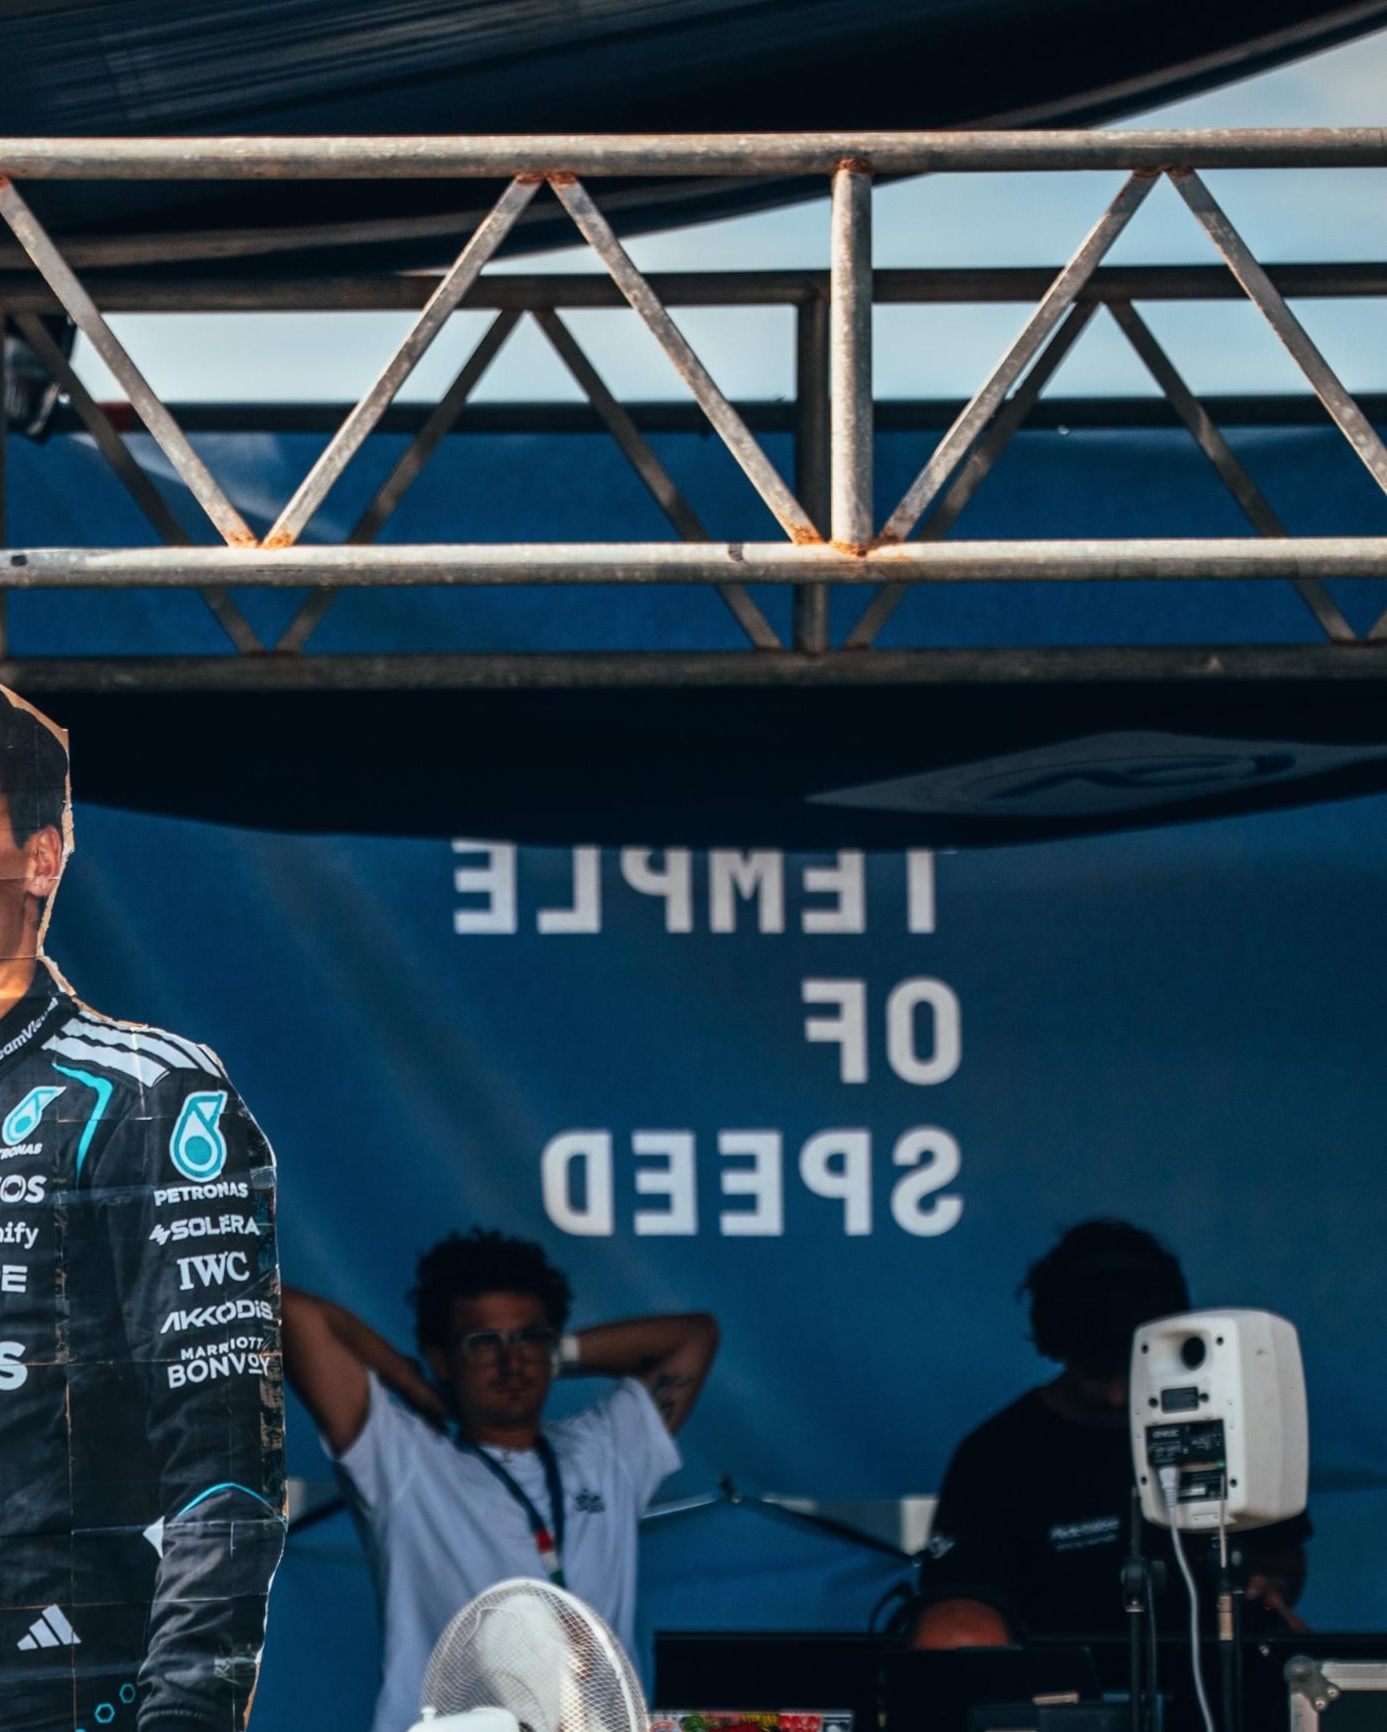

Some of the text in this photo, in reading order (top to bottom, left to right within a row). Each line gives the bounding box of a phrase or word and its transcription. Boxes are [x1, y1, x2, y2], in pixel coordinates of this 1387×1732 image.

[154, 1182, 249, 1207] PETRONAS
[170, 1214, 261, 1242] SOLERA
[176, 1251, 250, 1291] IWC
[180, 1336, 263, 1360] MARRIOTT
[167, 1352, 271, 1389] BONVOY
